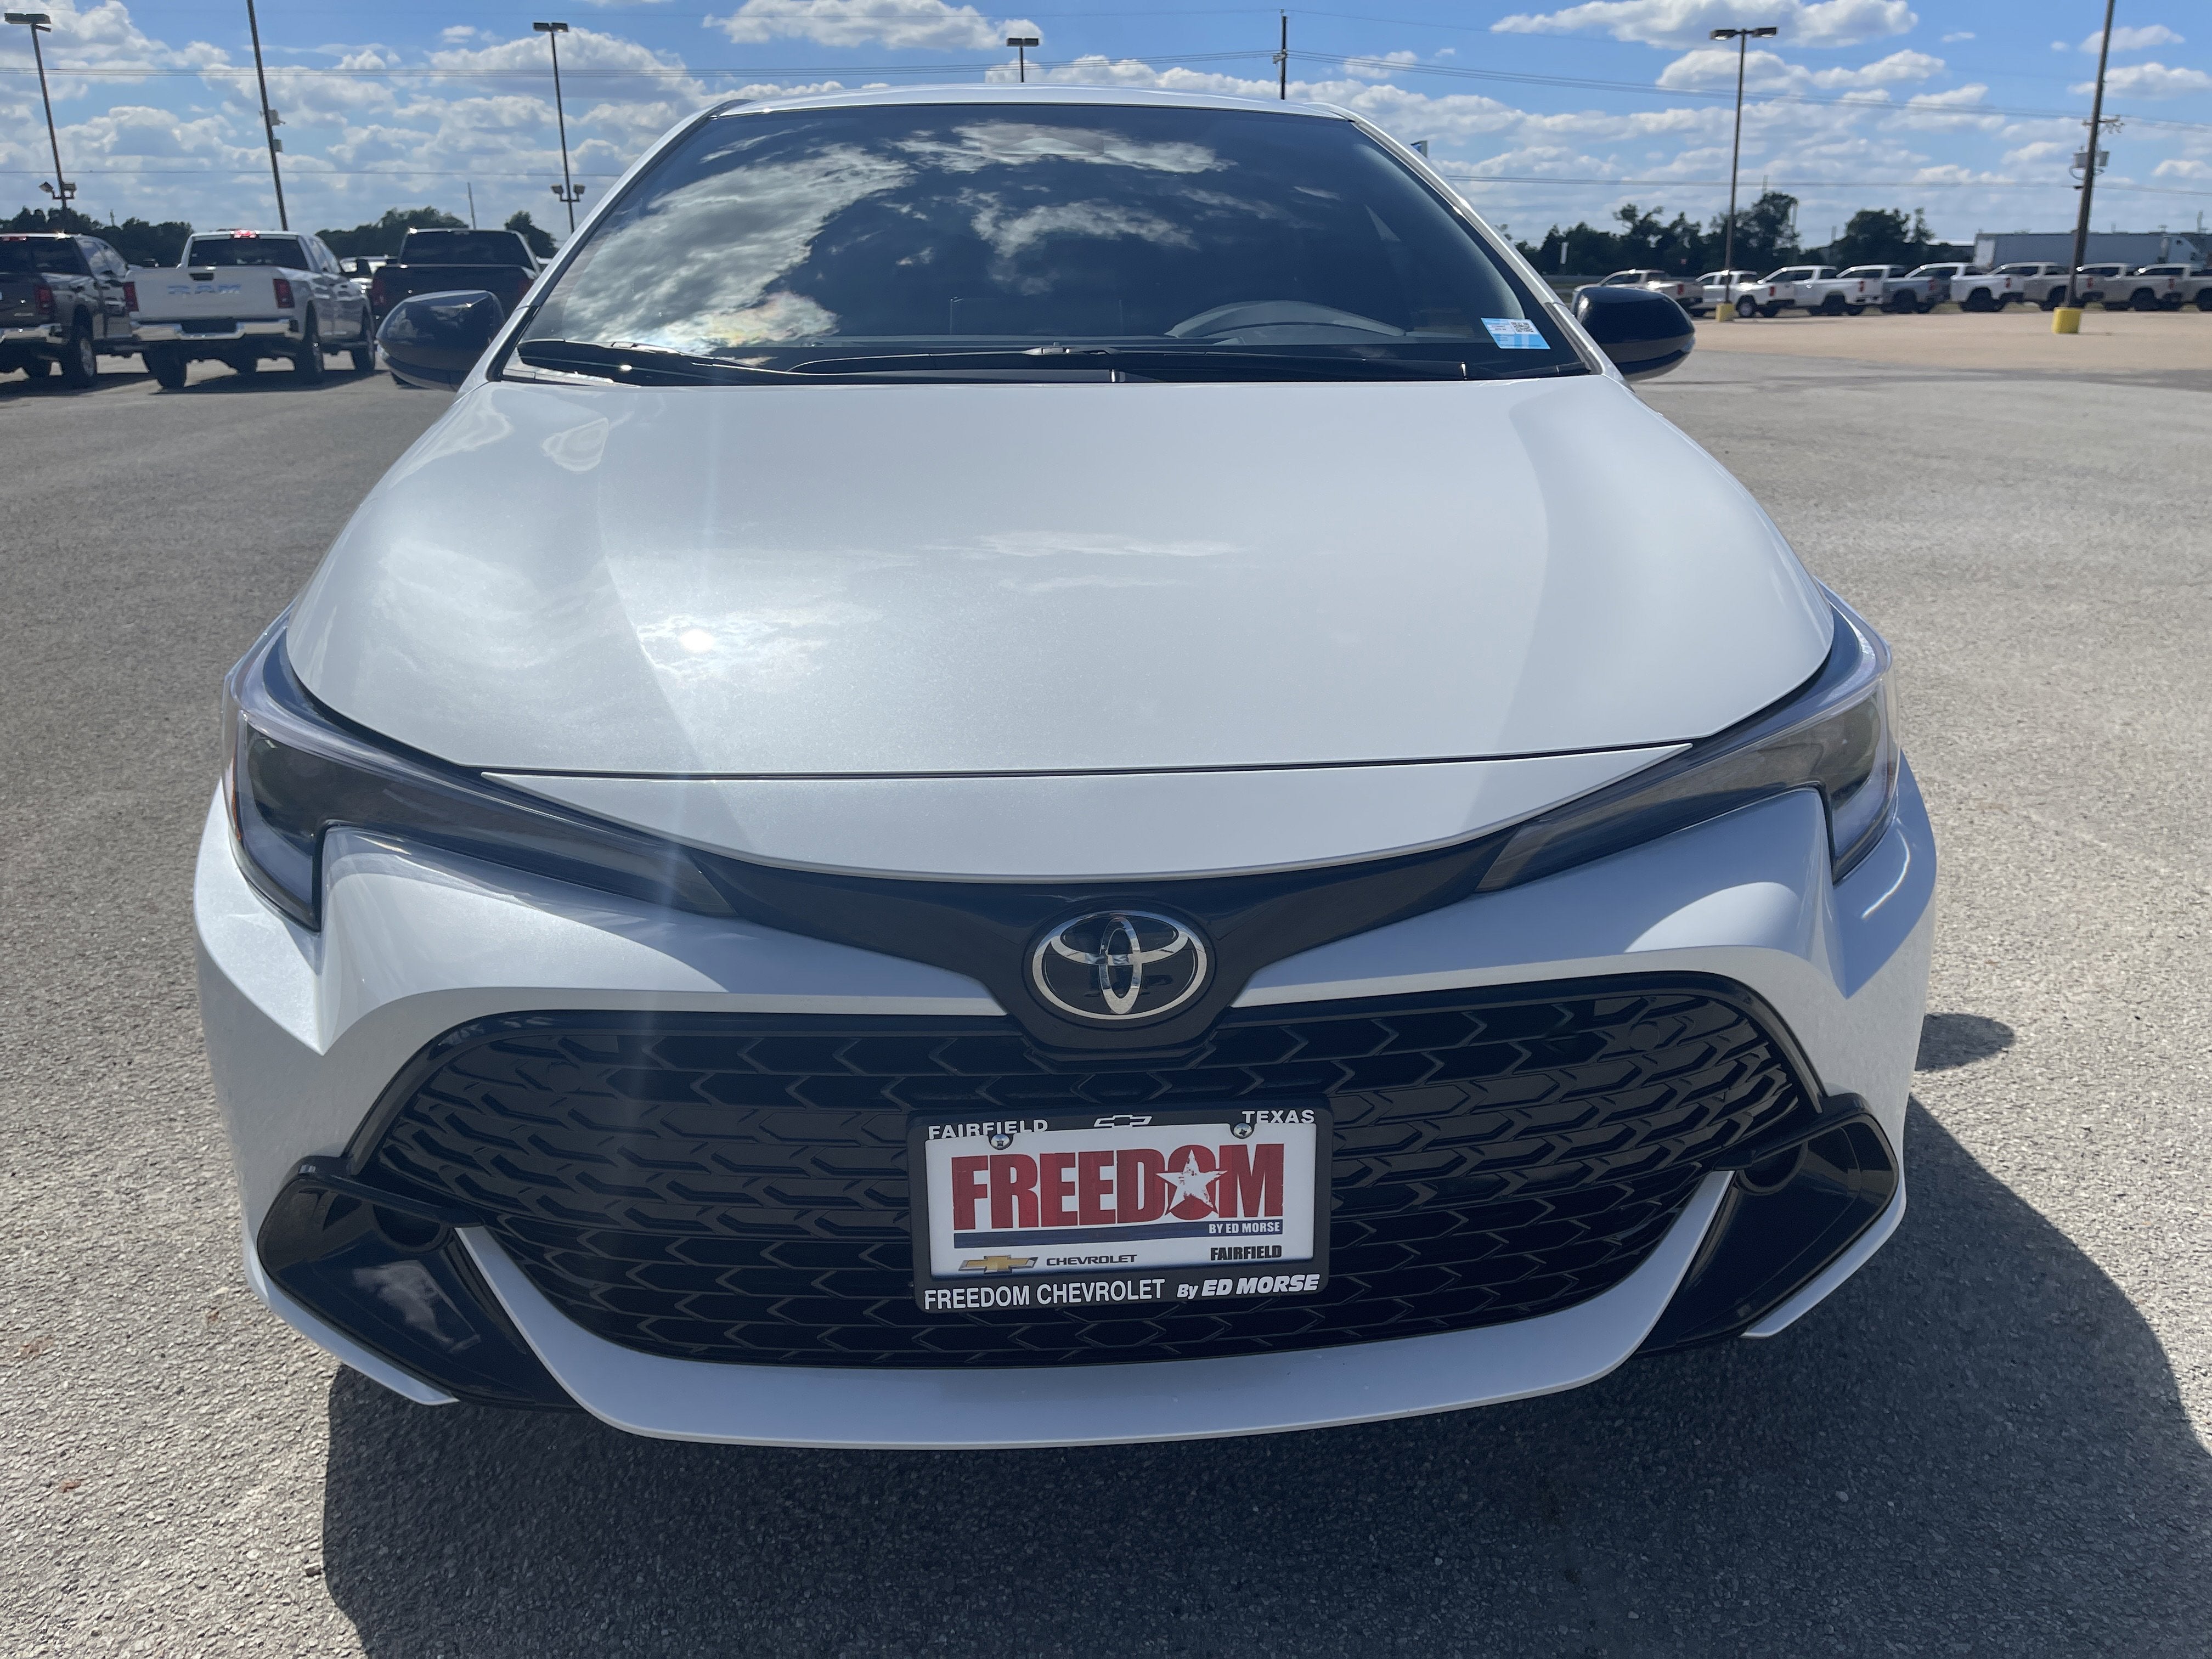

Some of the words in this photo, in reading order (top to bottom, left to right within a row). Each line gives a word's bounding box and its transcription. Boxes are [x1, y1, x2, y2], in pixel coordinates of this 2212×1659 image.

[1242, 1109, 1315, 1124] TEXAS
[928, 1119, 1048, 1140] FAIRFIELD
[951, 1143, 1284, 1230] FREEDOM
[1209, 1223, 1223, 1234] BY
[1226, 1223, 1239, 1234] ED
[1242, 1222, 1280, 1233] MORSE
[1046, 1254, 1138, 1266] CHEVROLET
[1210, 1245, 1282, 1261] FAIRFIELD
[924, 1285, 1030, 1310] FREEDOM
[1036, 1278, 1165, 1305] CHEVROLET
[1177, 1284, 1199, 1300] By
[1201, 1278, 1233, 1296] ED
[1236, 1274, 1320, 1295] MORSE
